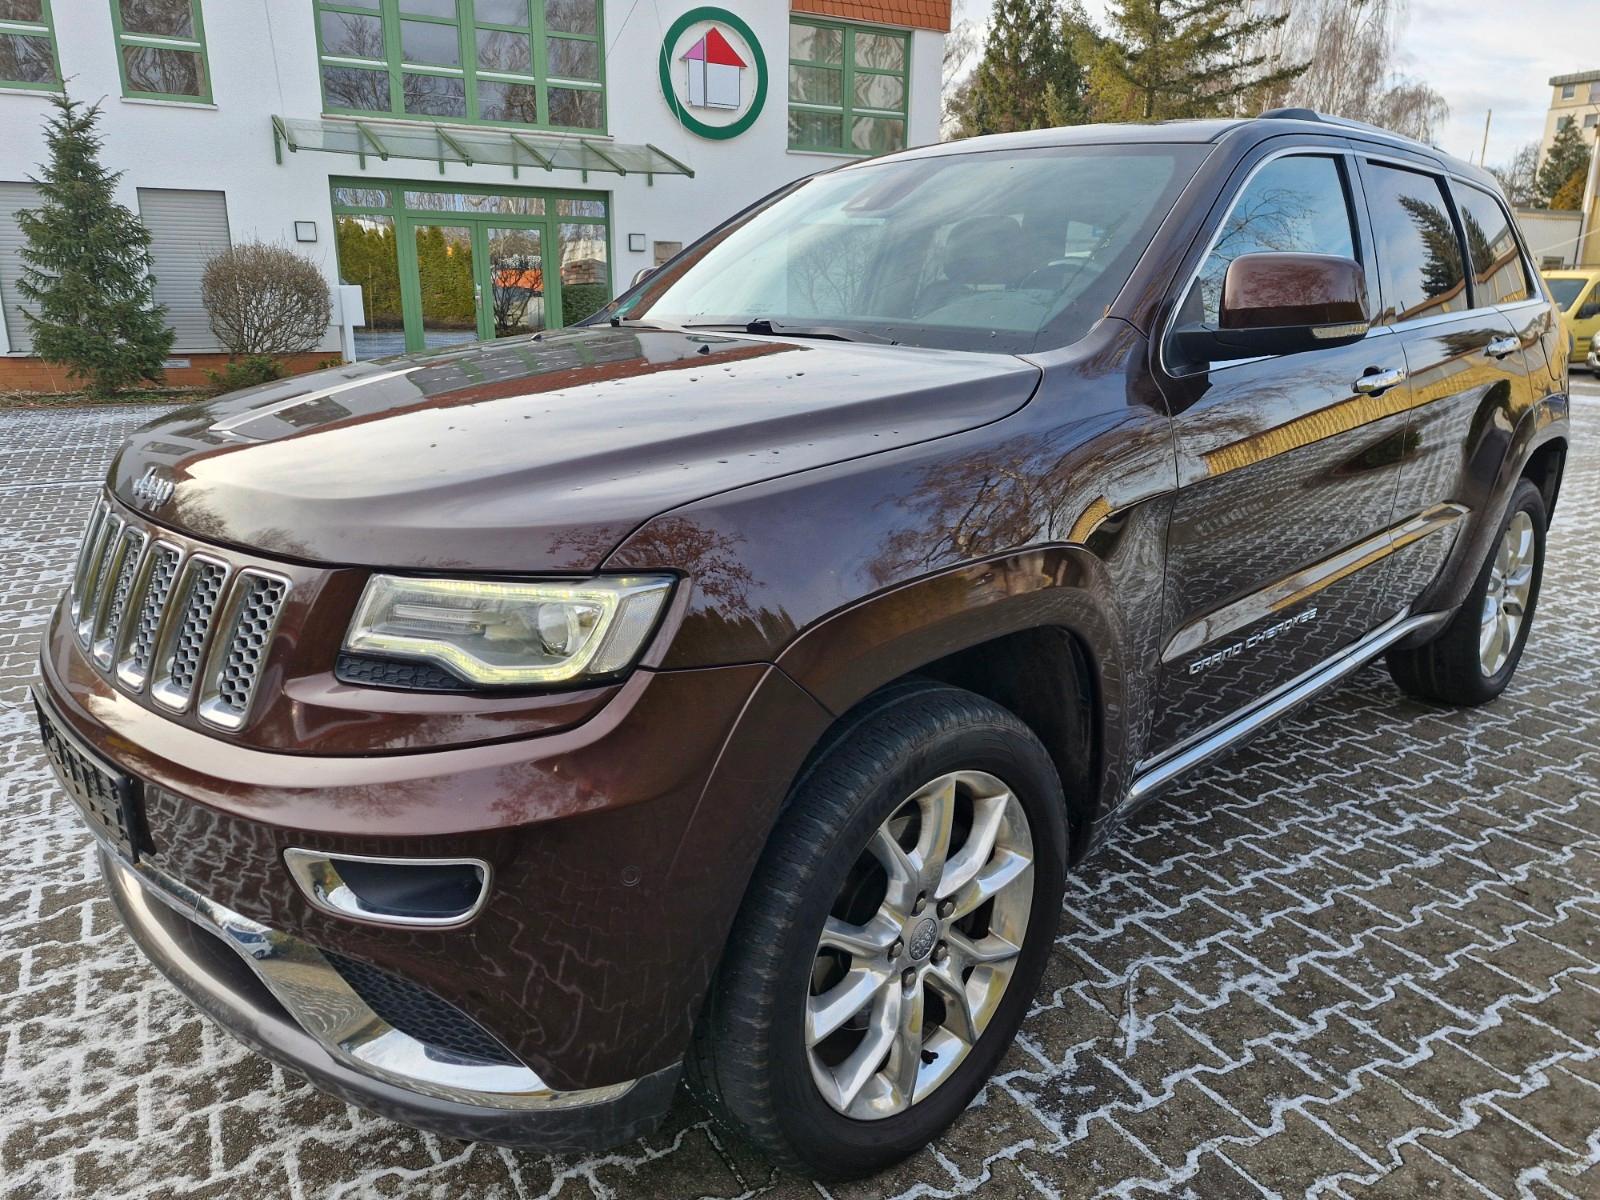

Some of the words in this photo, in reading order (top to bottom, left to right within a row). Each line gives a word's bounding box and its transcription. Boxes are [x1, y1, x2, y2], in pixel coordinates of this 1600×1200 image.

[133, 466, 174, 511] Jeep
[1189, 643, 1242, 675] GRAND
[1245, 607, 1318, 649] CHEROKEE
